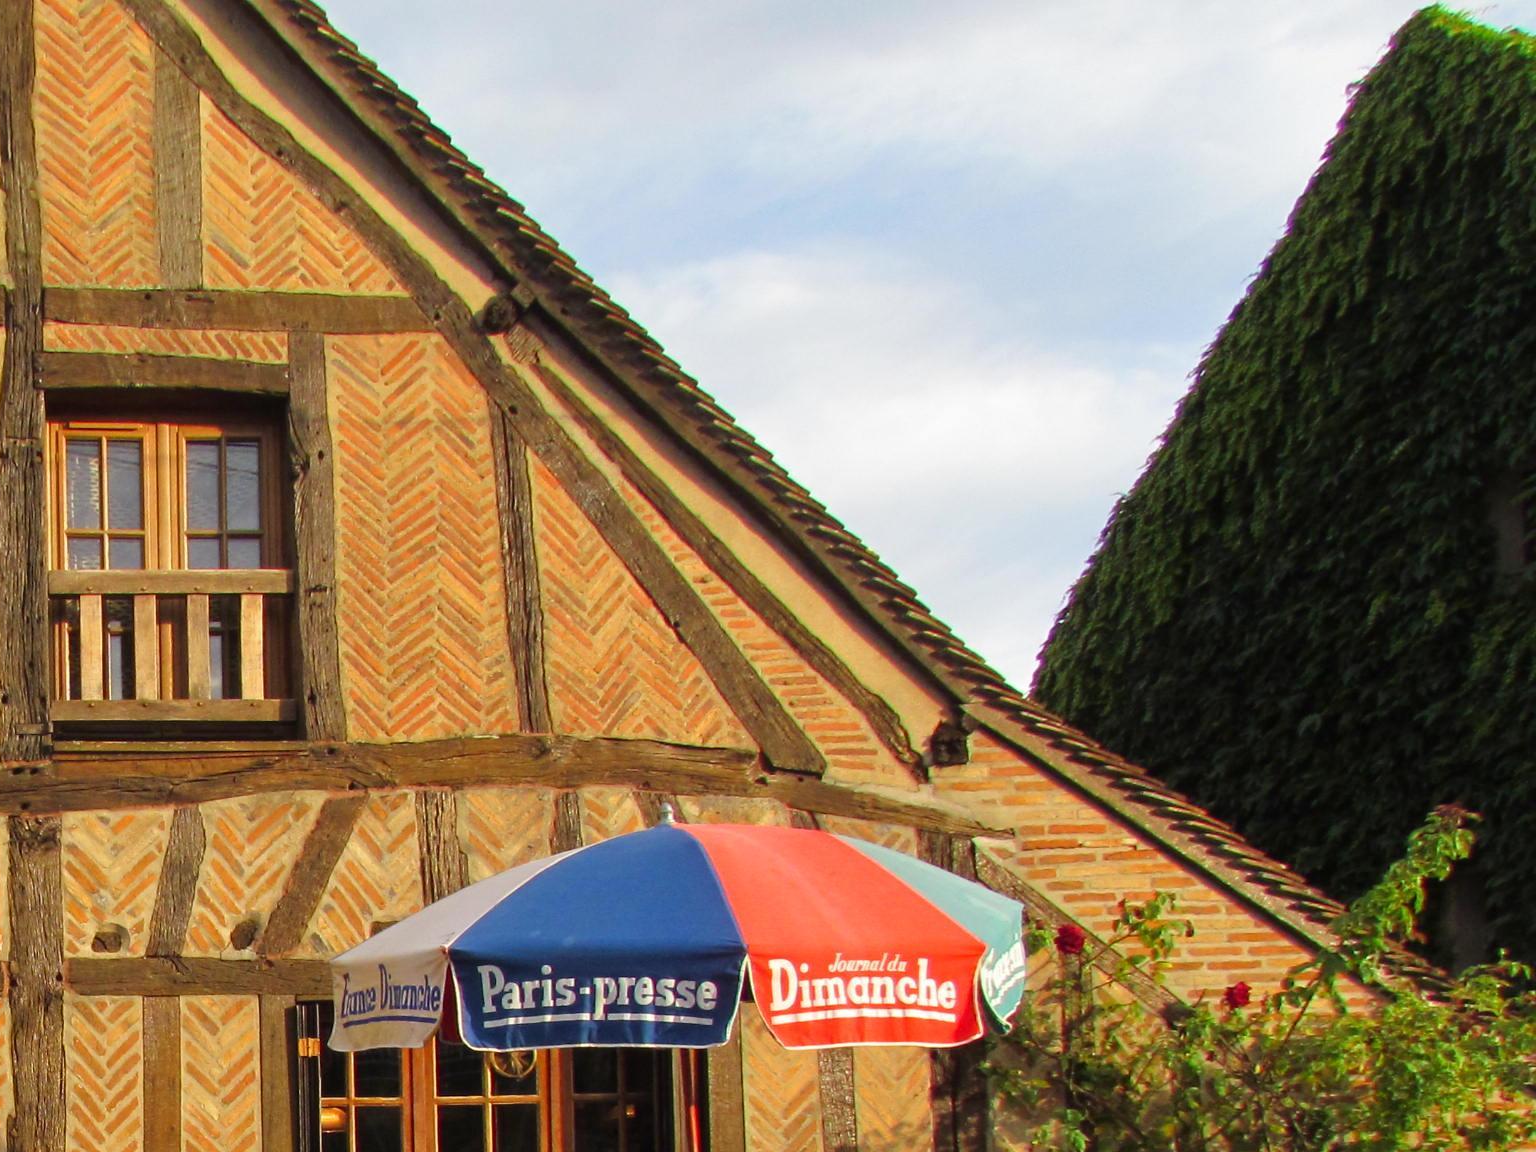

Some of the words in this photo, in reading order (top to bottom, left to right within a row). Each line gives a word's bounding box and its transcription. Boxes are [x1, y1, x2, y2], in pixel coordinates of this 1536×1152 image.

[378, 963, 441, 1012] Dimanche
[768, 958, 956, 1011] Dimanche
[828, 952, 885, 973] Journal
[887, 954, 907, 972] du
[476, 964, 718, 1020] Paris-presse
